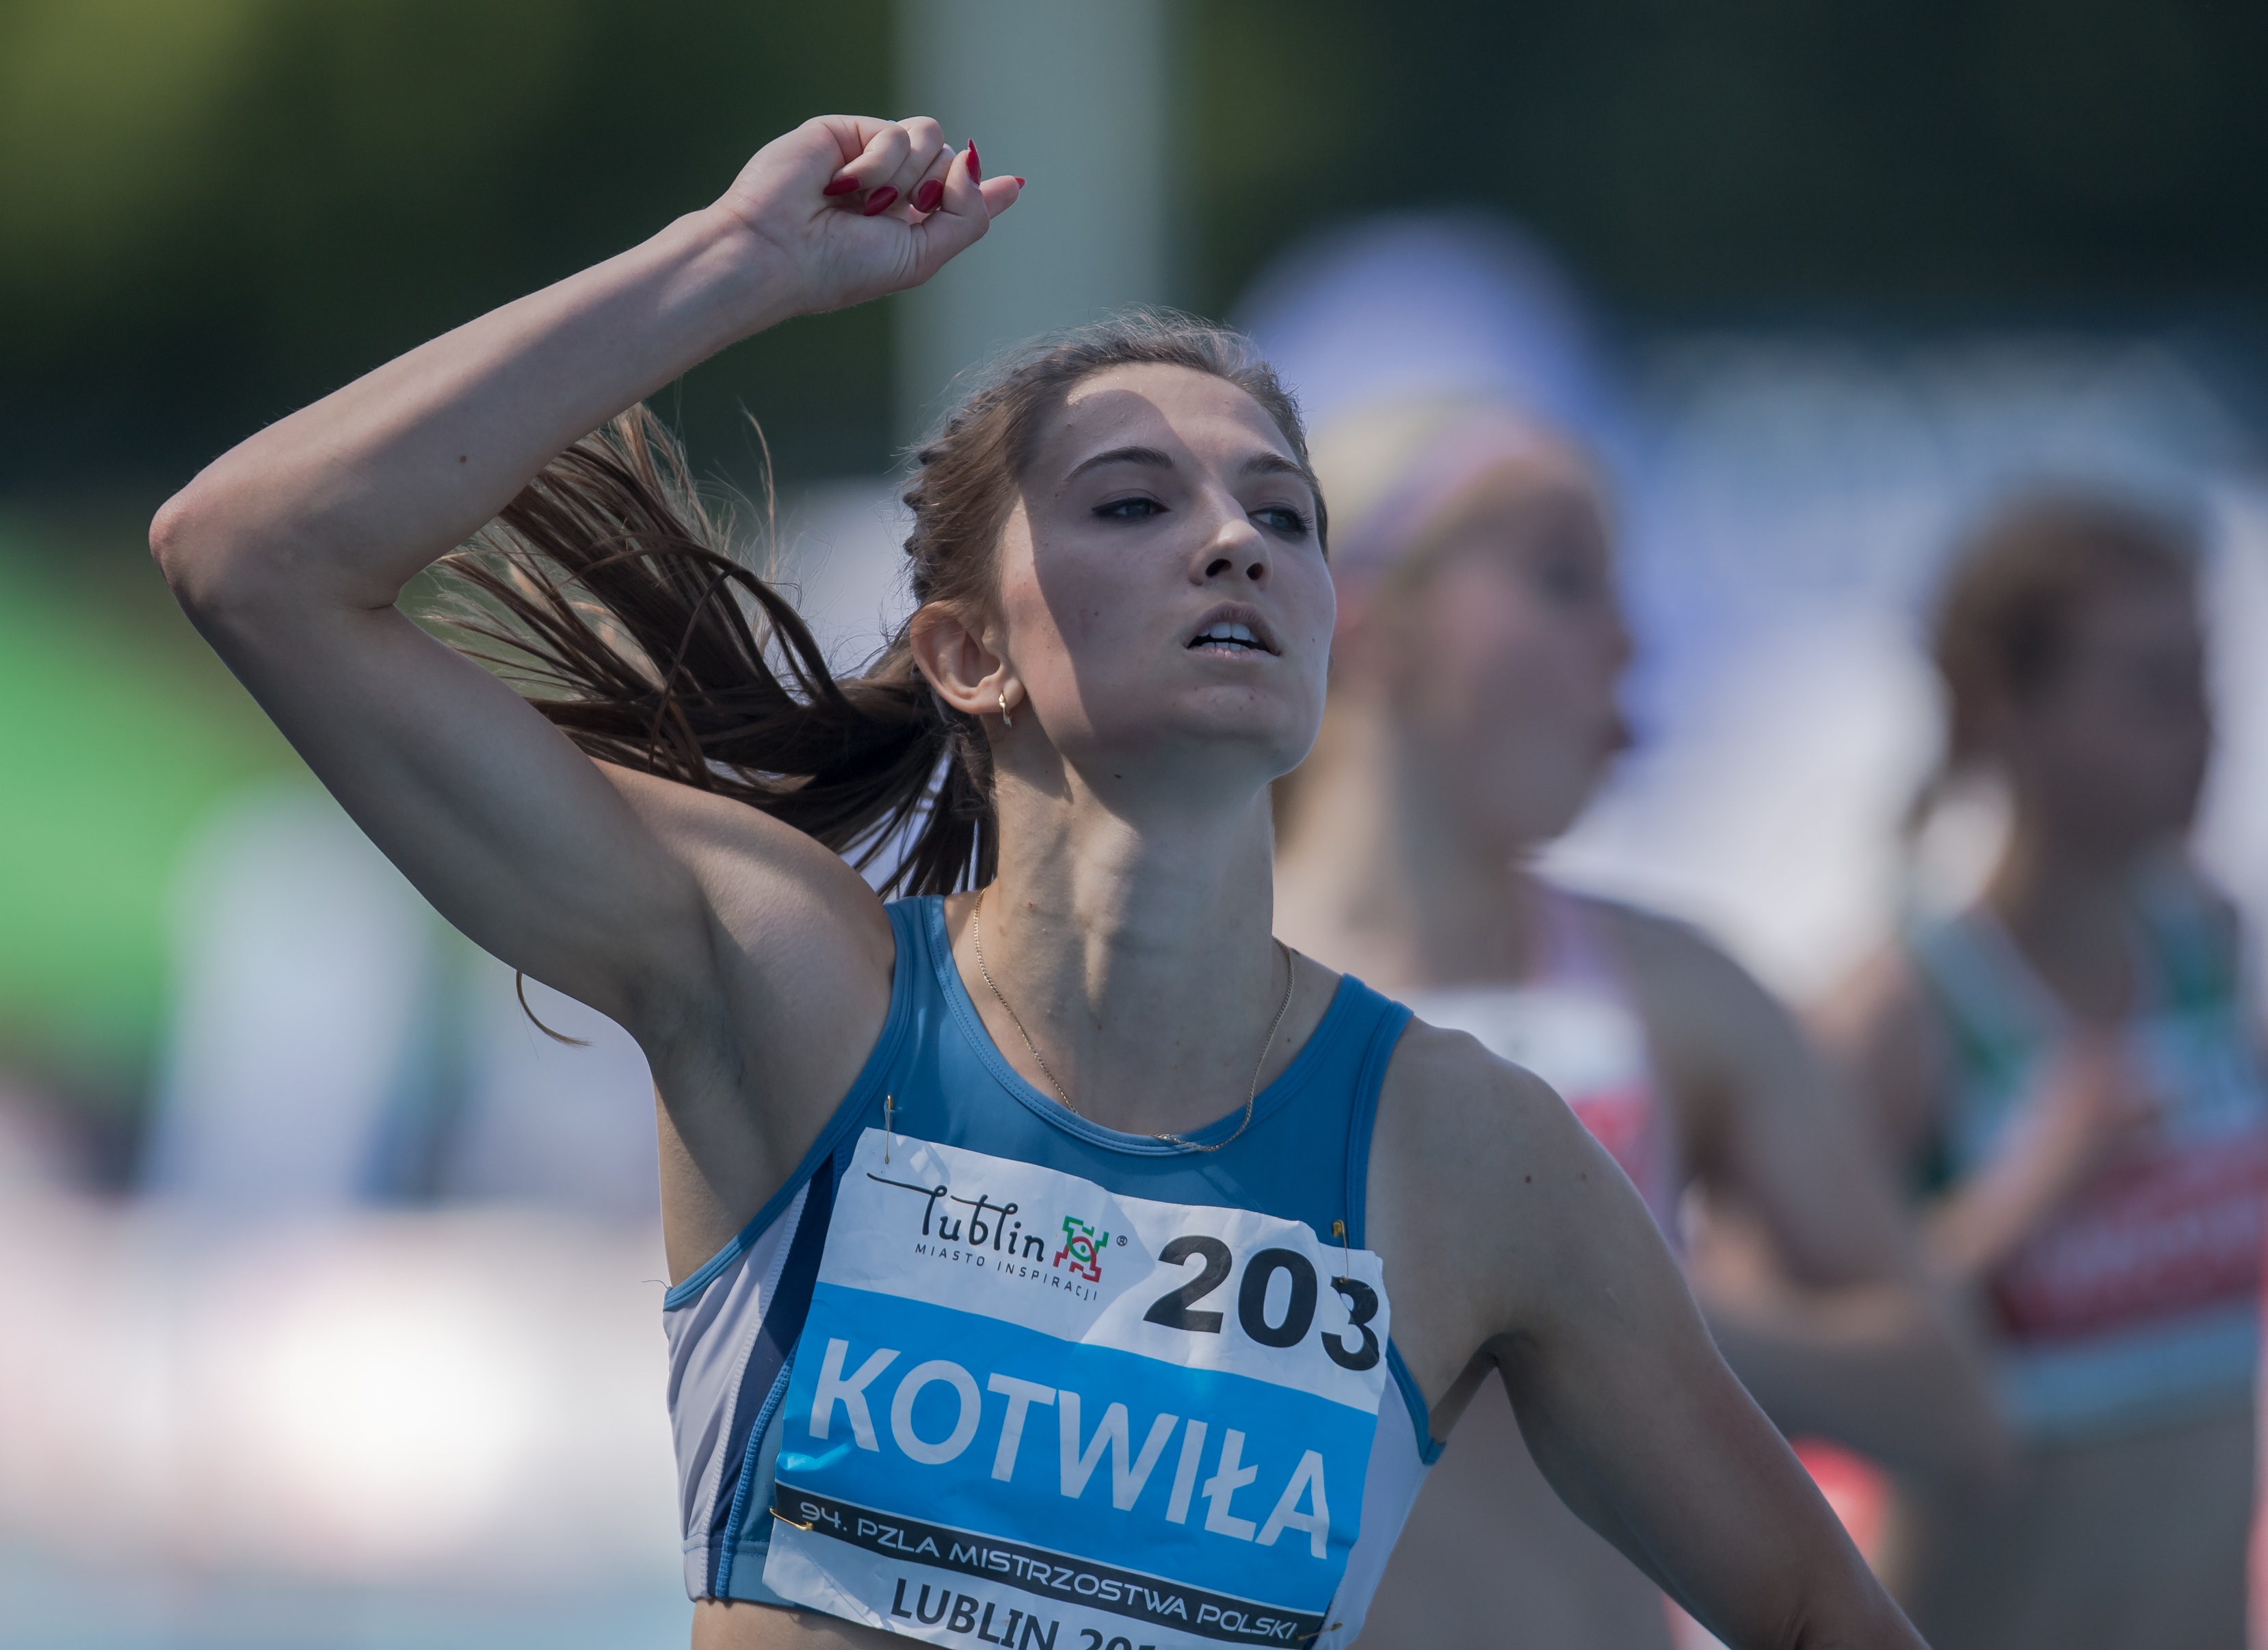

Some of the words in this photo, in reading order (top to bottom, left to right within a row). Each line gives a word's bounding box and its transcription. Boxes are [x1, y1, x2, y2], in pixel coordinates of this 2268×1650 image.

[915, 1243, 986, 1267] MIASTO
[997, 1261, 1097, 1300] INSPIRACJI
[1143, 1235, 1380, 1371] 203
[809, 1337, 1330, 1560] KOTWIŁA
[800, 1501, 848, 1532] 94.
[857, 1518, 940, 1558] PZLA
[949, 1543, 1188, 1621] MISTRZOSTWA
[1196, 1603, 1298, 1640] POLSKI
[891, 1577, 1060, 1650] LUBLIN
